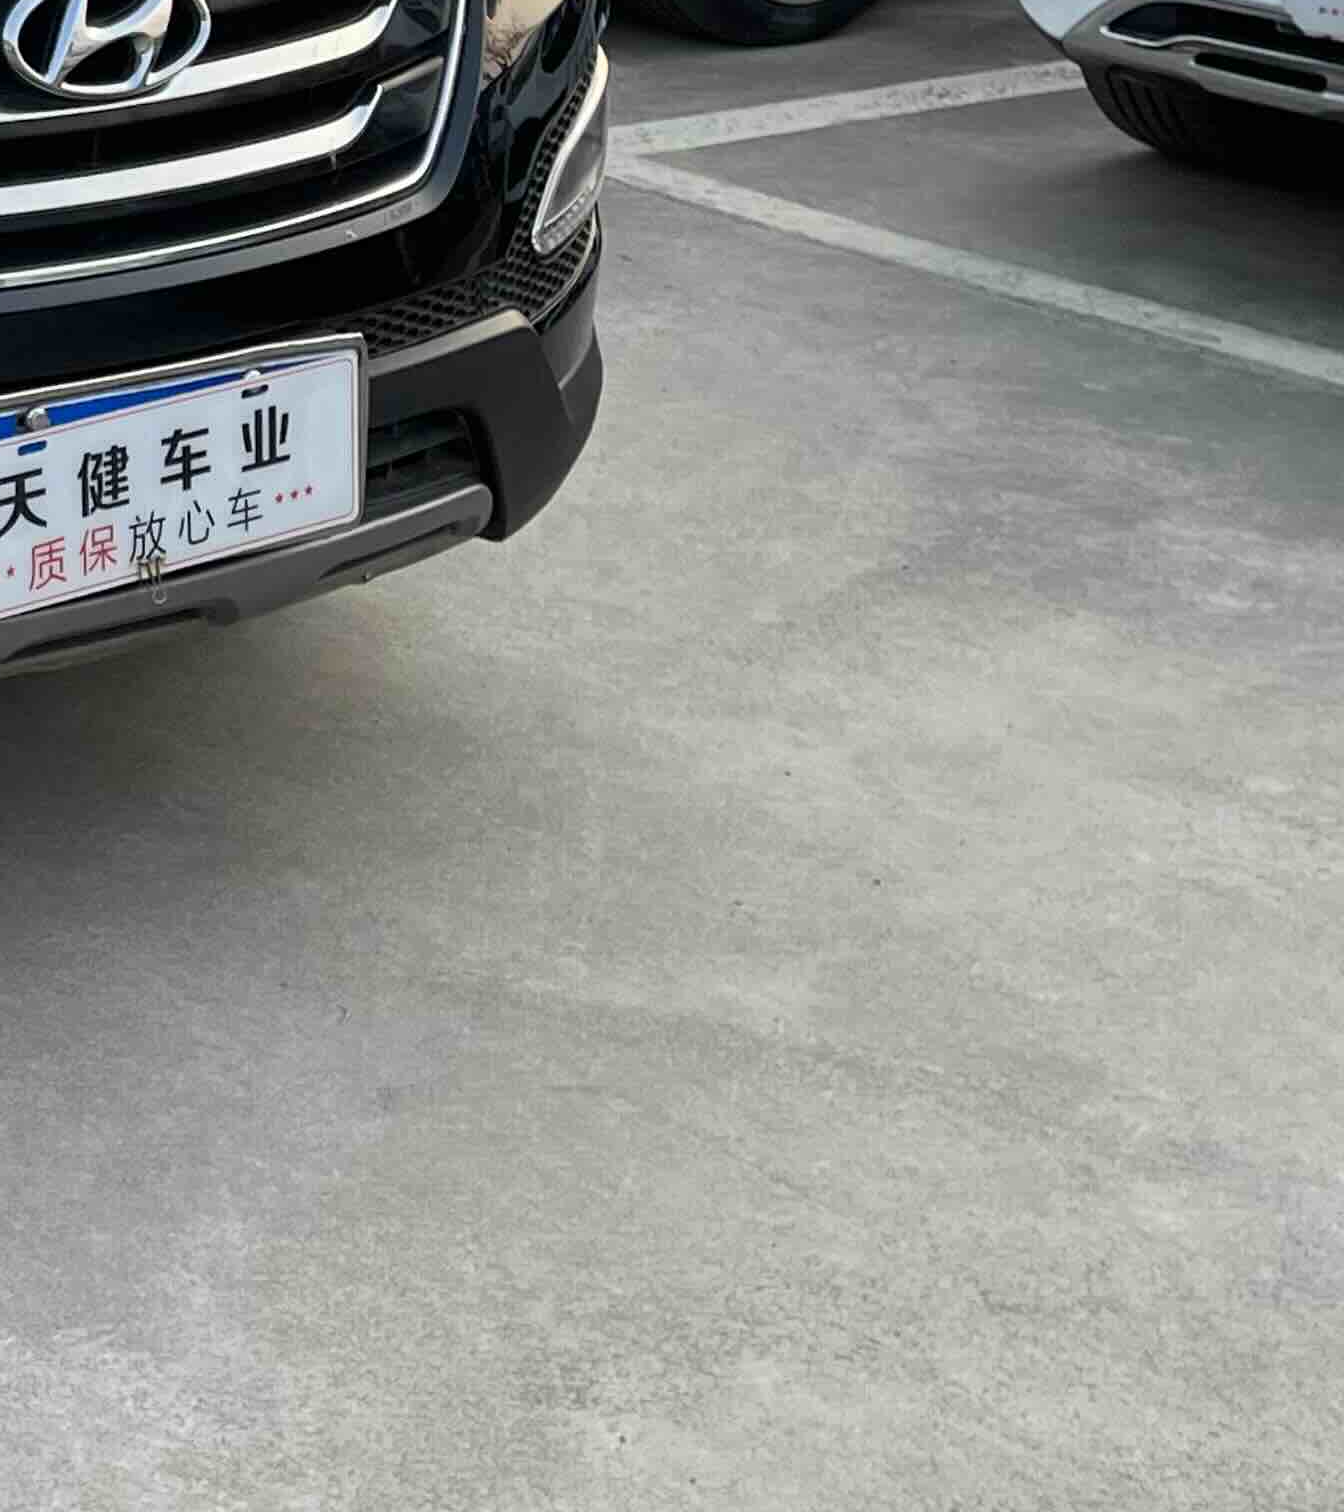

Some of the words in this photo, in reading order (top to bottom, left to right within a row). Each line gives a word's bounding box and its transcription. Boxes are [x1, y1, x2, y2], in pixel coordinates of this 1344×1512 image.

[28, 487, 265, 592] 质保放心车
